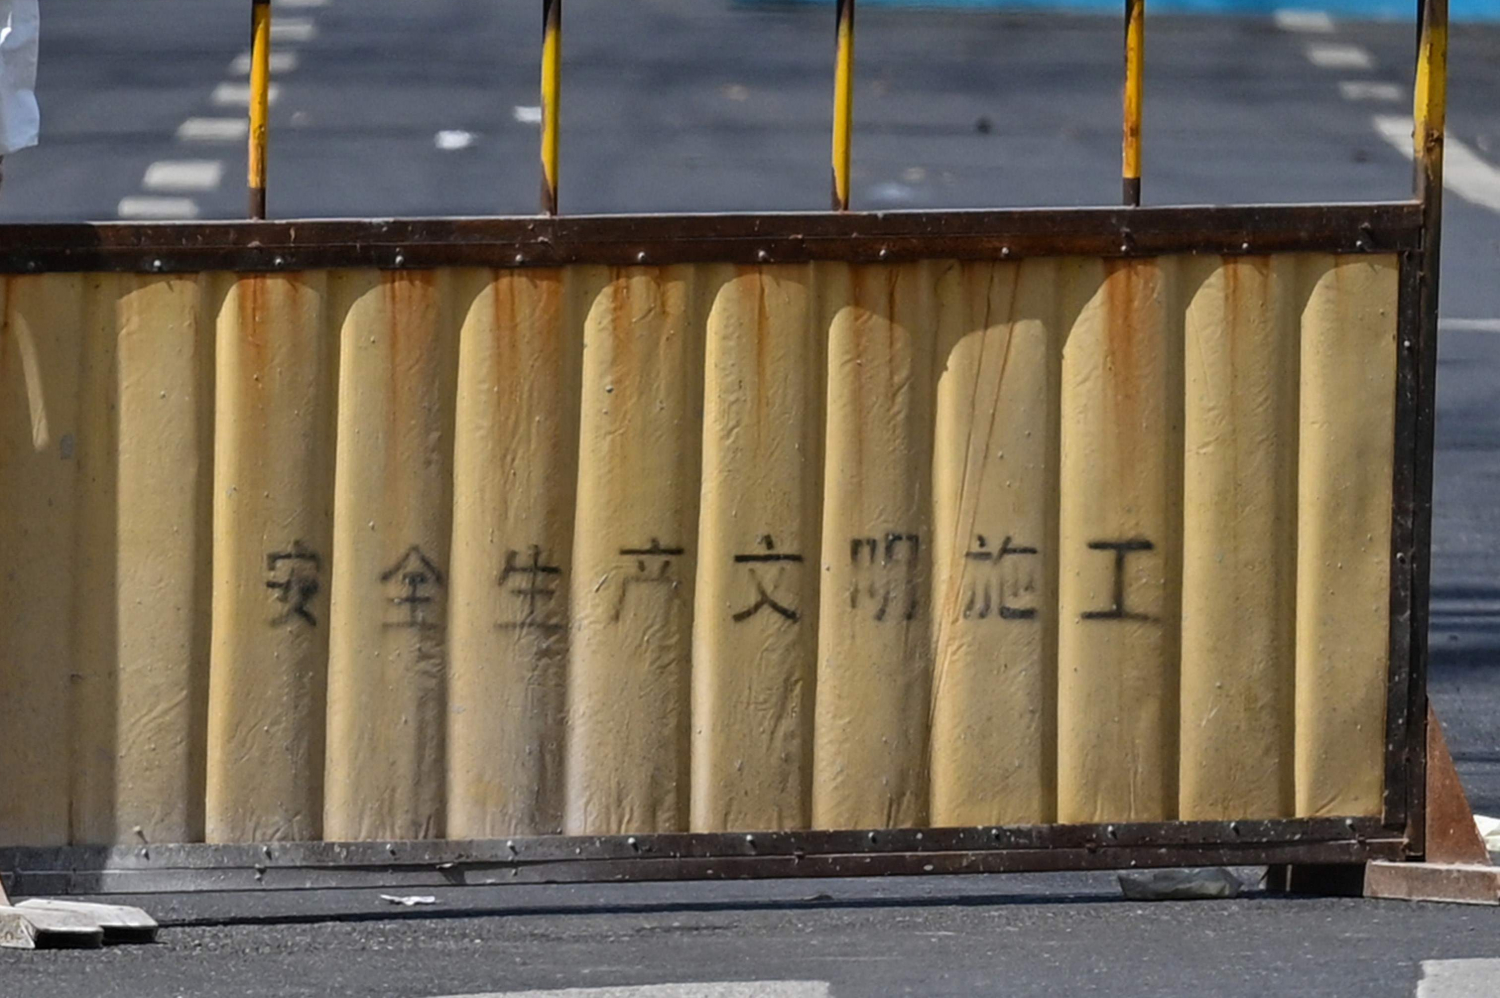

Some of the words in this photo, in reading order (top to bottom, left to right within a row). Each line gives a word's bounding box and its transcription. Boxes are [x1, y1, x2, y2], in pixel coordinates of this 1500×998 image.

[266, 534, 1160, 630] 安全生产文明施工
